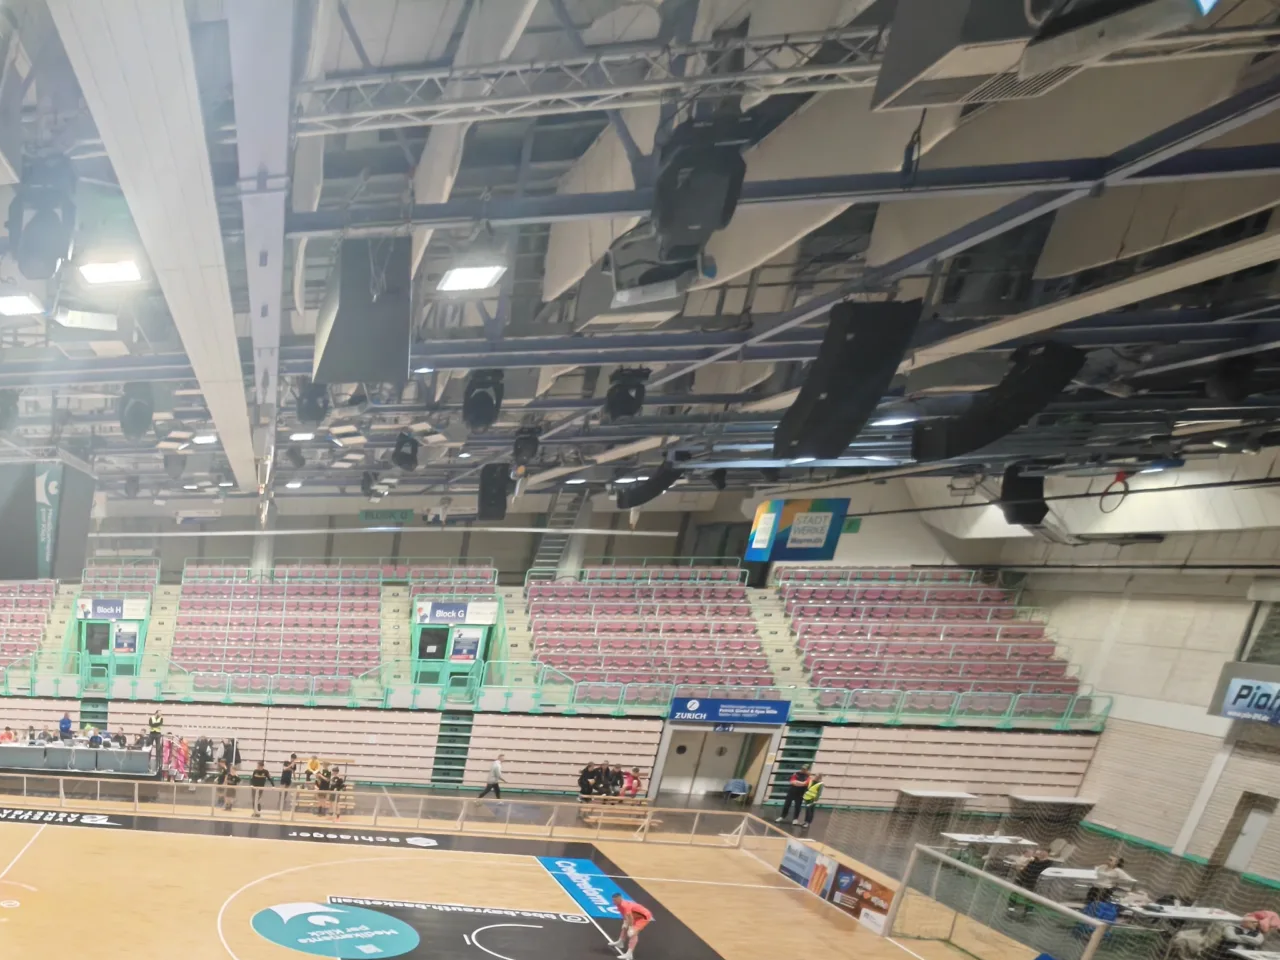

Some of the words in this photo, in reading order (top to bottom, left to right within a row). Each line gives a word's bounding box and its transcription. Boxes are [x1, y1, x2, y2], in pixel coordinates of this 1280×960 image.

[96, 605, 115, 614] Block
[435, 609, 456, 618] Block
[457, 610, 465, 618] G
[674, 712, 707, 720] ZURICH
[288, 831, 400, 843] schlaeger
[331, 897, 557, 920] bbc.bayreuth.basketball
[308, 928, 345, 936] Klick
[346, 924, 370, 933] per
[297, 928, 399, 944] Medikamente
